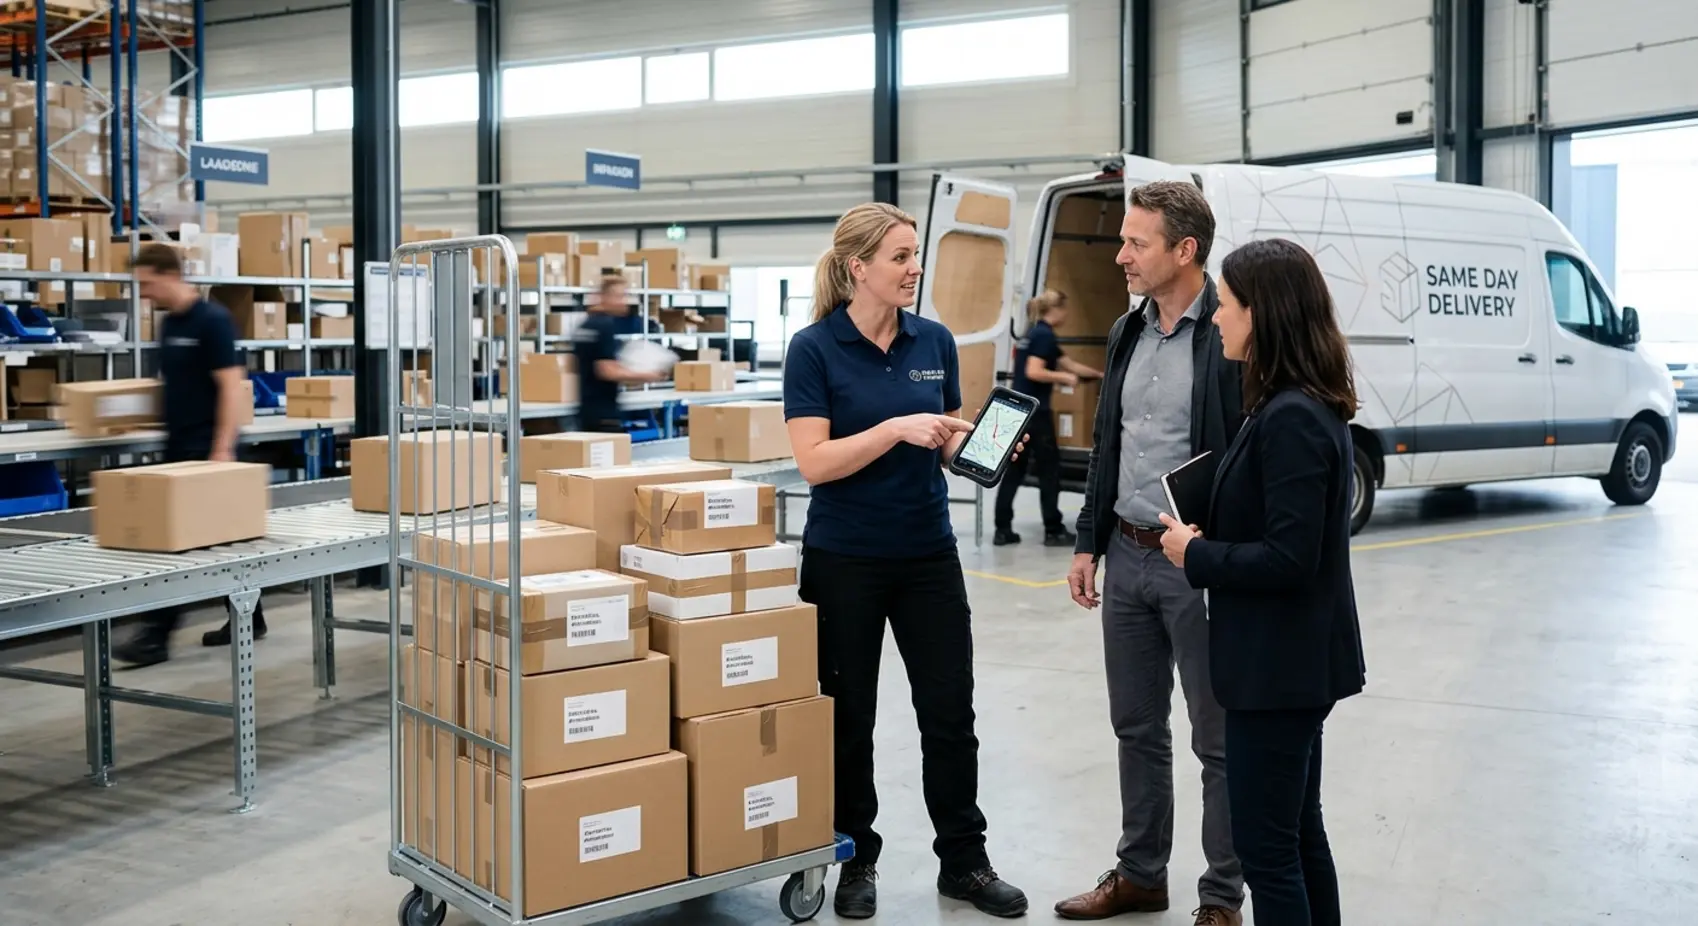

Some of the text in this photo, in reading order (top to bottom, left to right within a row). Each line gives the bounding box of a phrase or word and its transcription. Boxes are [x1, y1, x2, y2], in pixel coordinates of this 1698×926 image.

[1427, 265, 1518, 290] SAME DAY
[1428, 294, 1515, 316] DELIVERY
